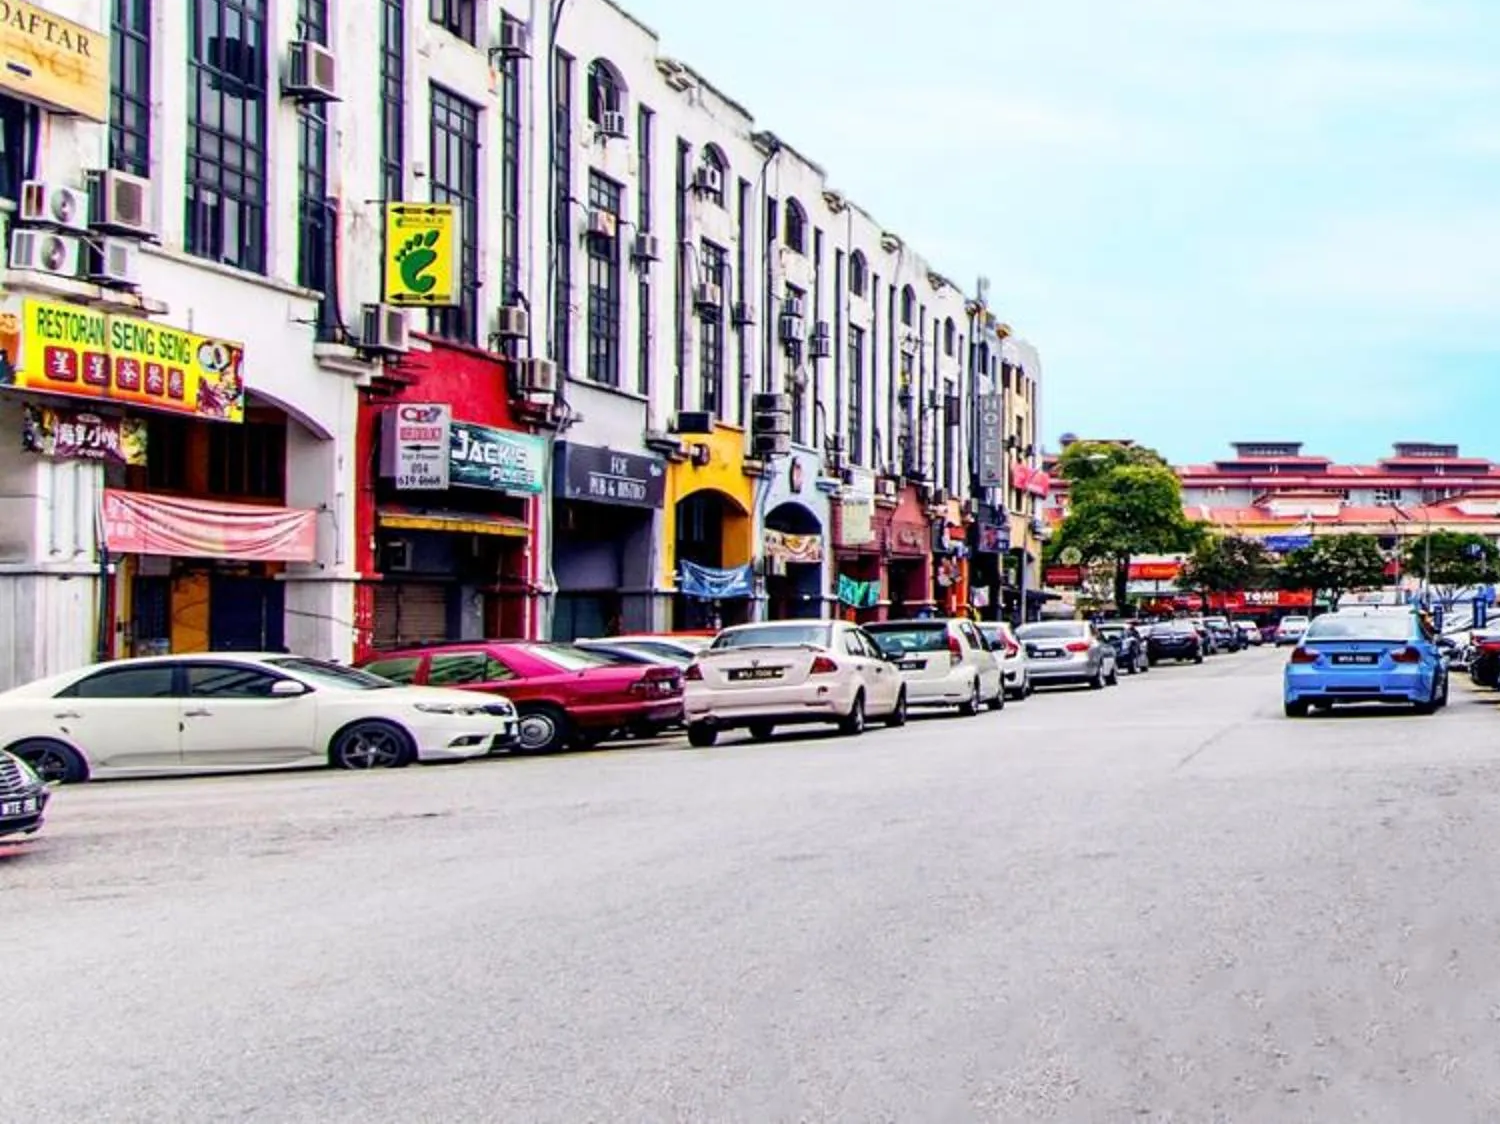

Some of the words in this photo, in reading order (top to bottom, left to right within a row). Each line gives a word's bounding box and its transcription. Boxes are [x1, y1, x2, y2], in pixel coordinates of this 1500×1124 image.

[37, 306, 106, 346] RESTORAN
[112, 321, 155, 355] SENG
[159, 330, 191, 365] SENG
[451, 429, 528, 469] JACK'S
